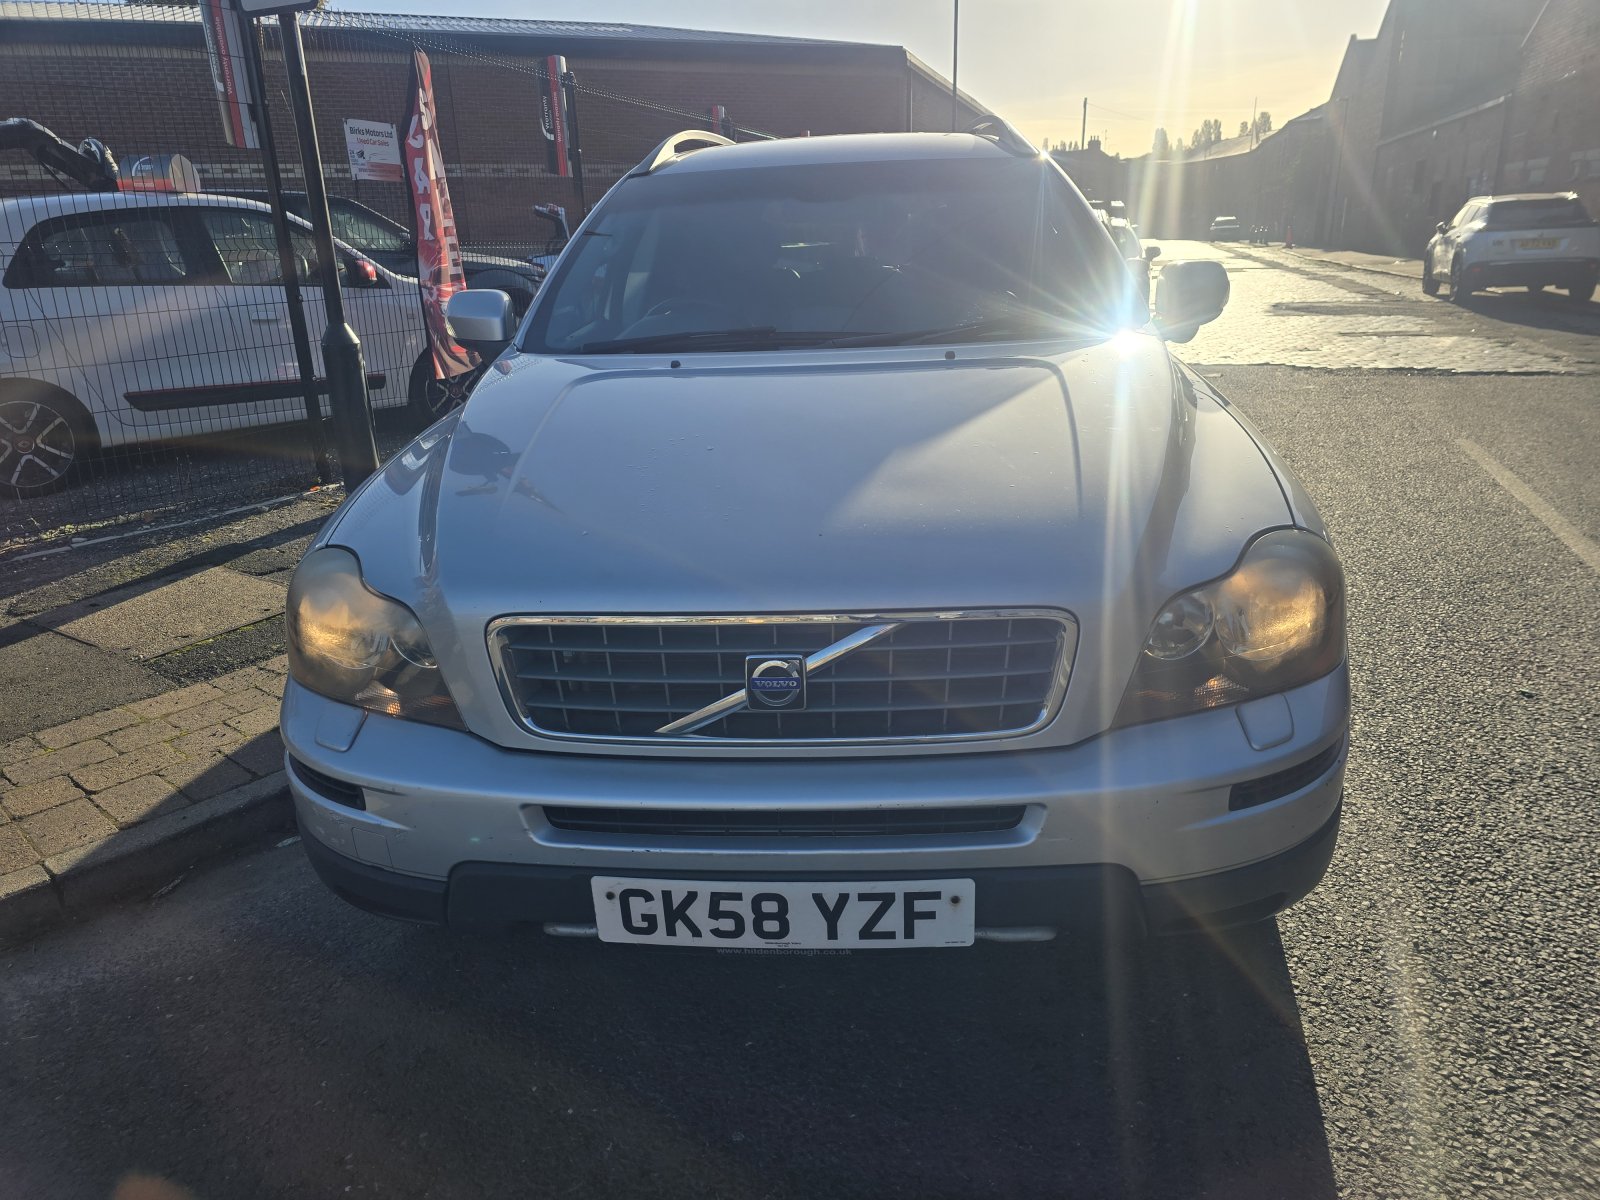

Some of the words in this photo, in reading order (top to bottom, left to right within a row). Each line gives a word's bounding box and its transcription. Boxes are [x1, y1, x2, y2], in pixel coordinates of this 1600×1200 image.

[215, 16, 225, 55] available
[223, 56, 233, 95] Warranty
[349, 126, 365, 136] Birks
[364, 128, 385, 138] Motors
[384, 130, 394, 139] Ltd
[754, 680, 797, 688] VOLVO
[618, 887, 791, 941] GK58
[811, 890, 942, 941] YZF
[716, 946, 852, 957] www.hildenborough.co.uk
